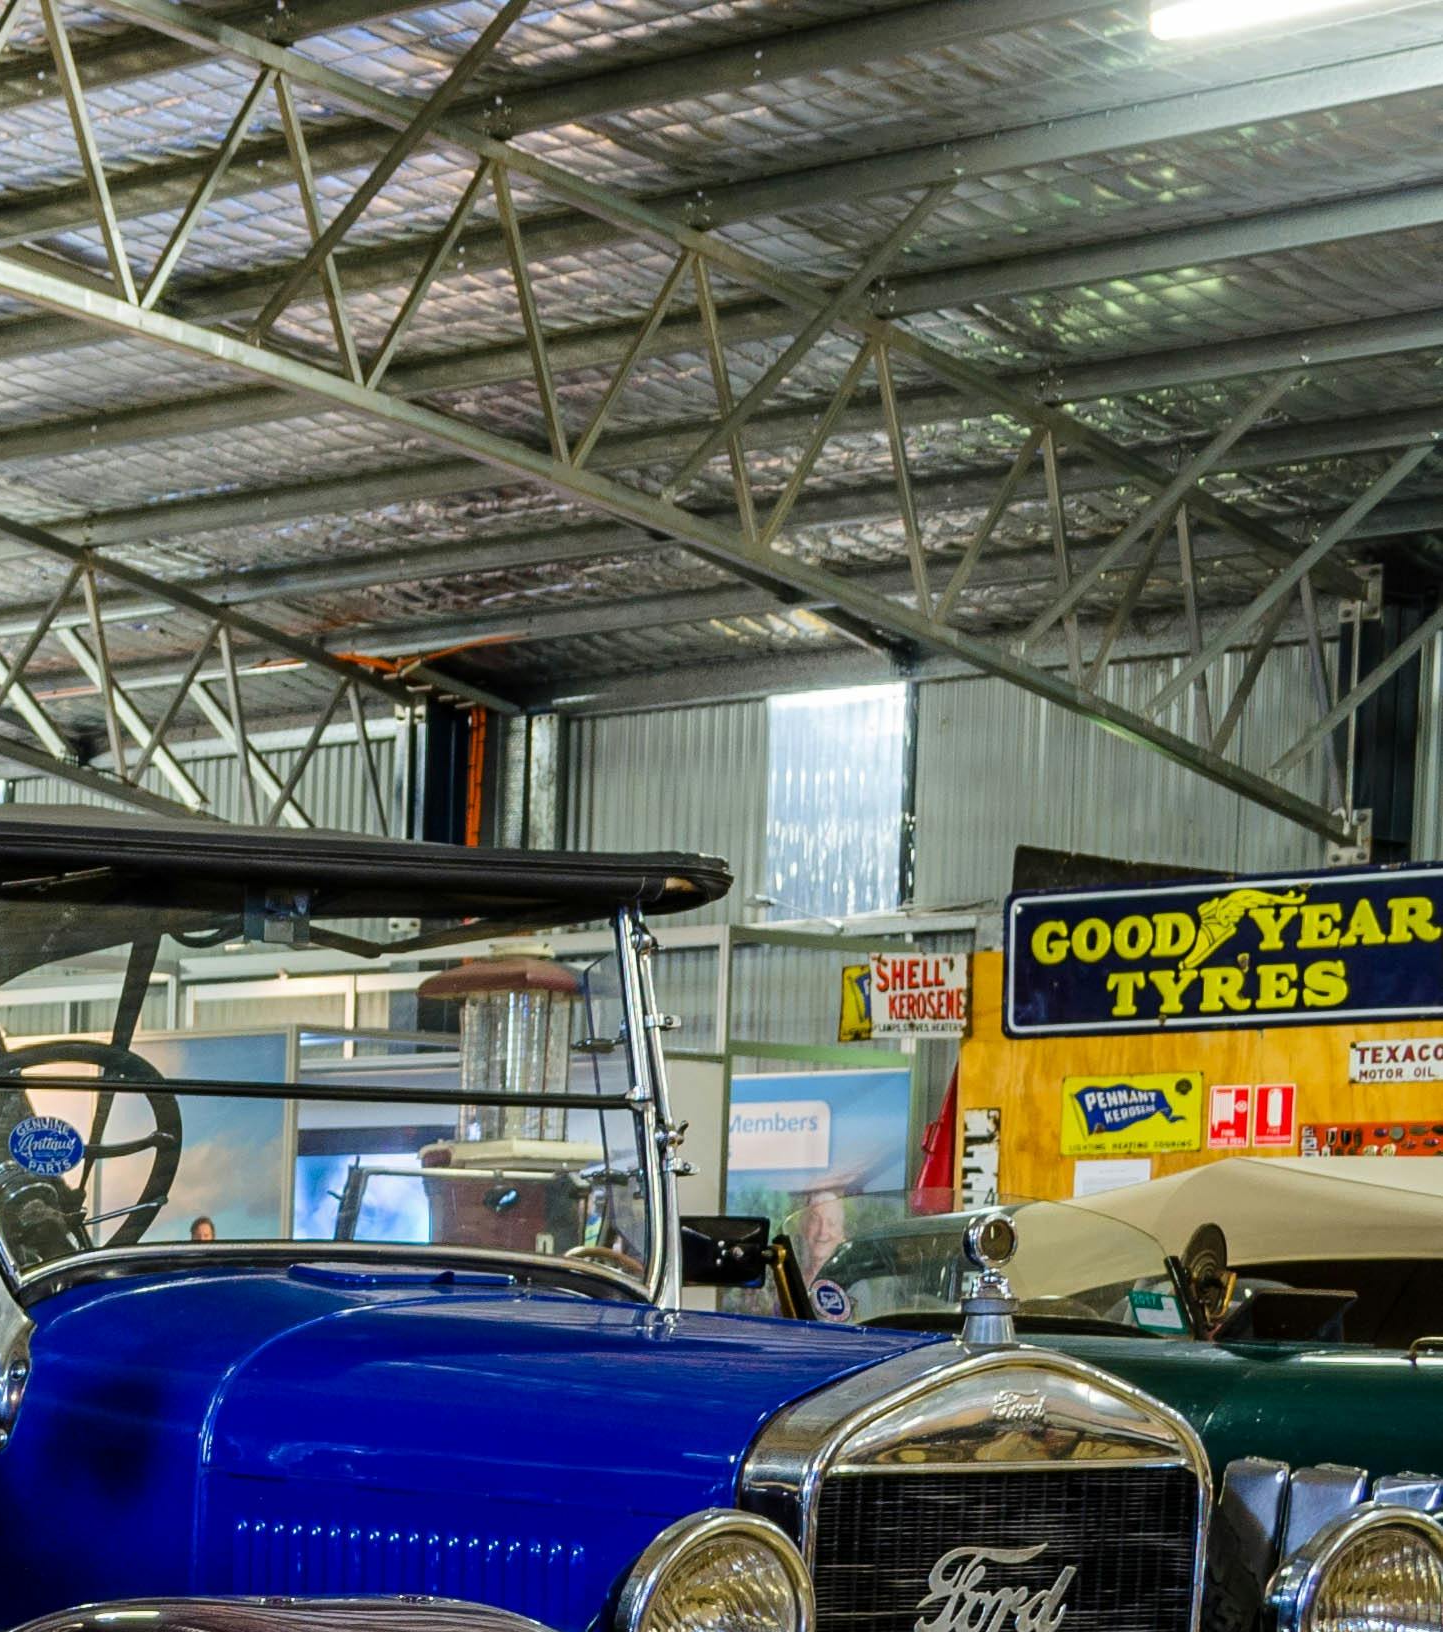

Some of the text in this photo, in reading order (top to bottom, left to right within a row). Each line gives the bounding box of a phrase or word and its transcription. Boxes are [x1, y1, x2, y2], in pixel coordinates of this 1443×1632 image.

[1106, 959, 1350, 1017] TYRES
[888, 988, 966, 1020] KEROSENE
[1355, 1044, 1443, 1065] TEXACO
[1358, 1066, 1436, 1081] MOTOR OIL
[1084, 1090, 1157, 1112] PENNANT
[1103, 1104, 1156, 1126] KEROSENE
[16, 1117, 69, 1136] GENUINE
[14, 1134, 77, 1158] Antique
[28, 1158, 71, 1174] PARTS
[992, 1388, 1047, 1419] Ford
